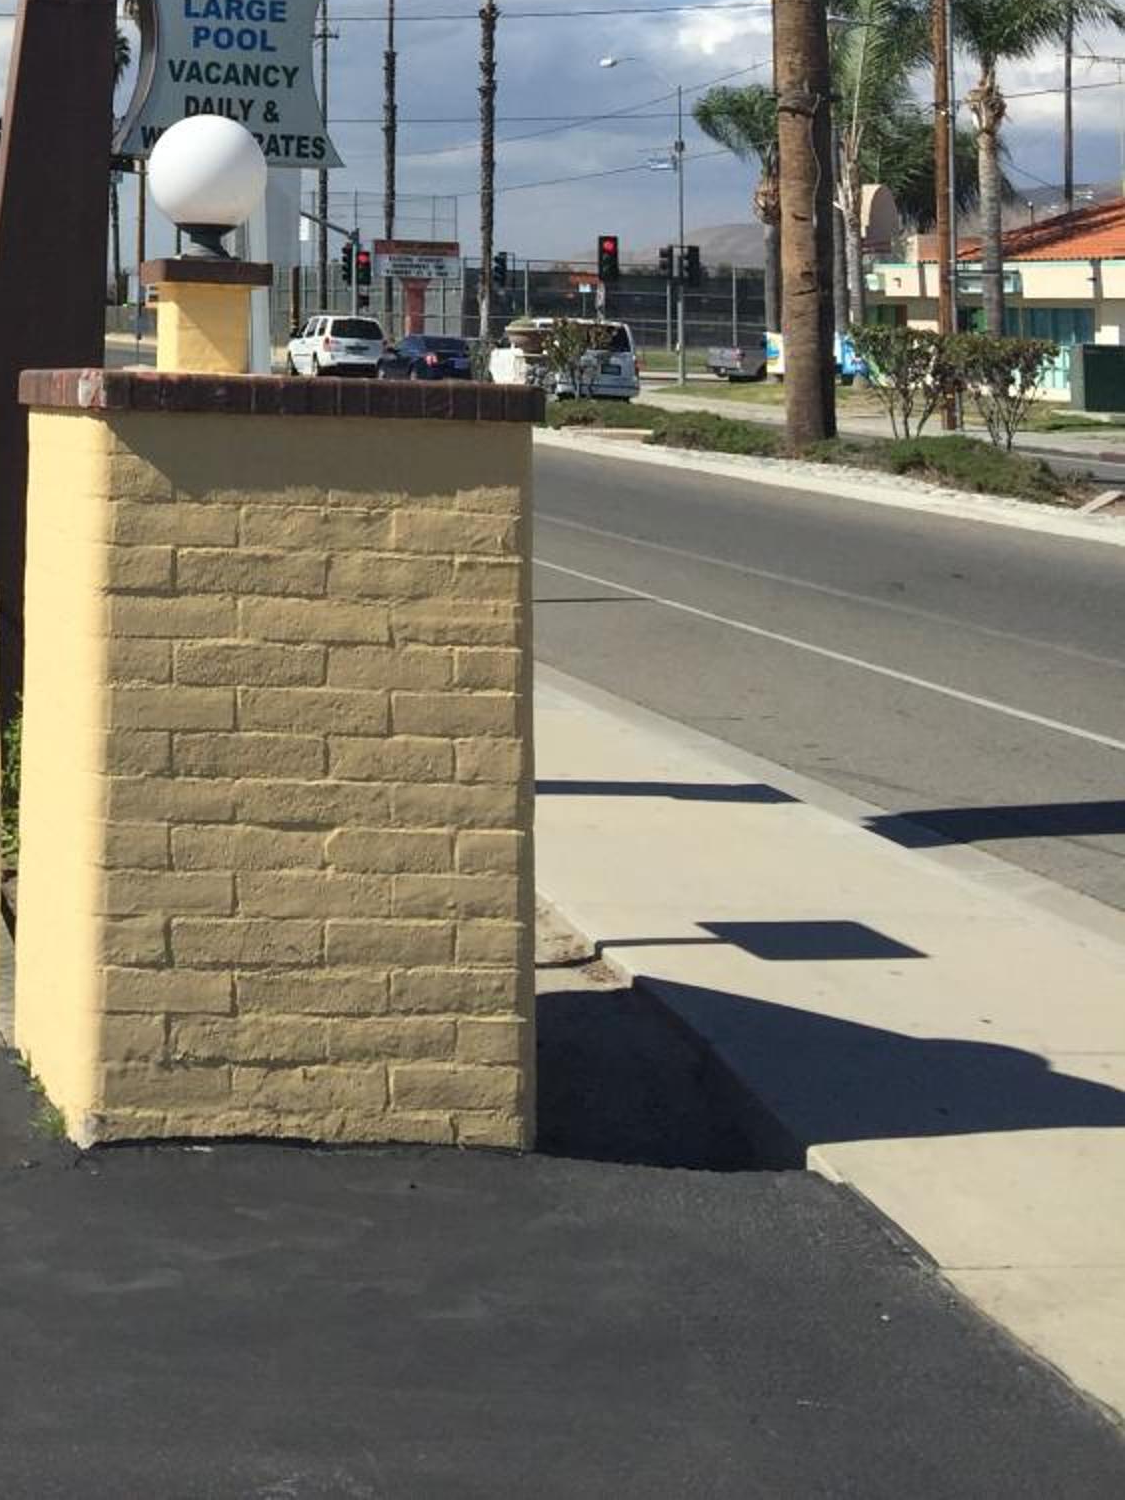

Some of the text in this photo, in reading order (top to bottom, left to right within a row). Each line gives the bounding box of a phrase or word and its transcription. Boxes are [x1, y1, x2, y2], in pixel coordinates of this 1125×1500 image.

[192, 26, 278, 53] POOL
[168, 59, 299, 88] VACANCY
[184, 95, 280, 124] DAILY &
